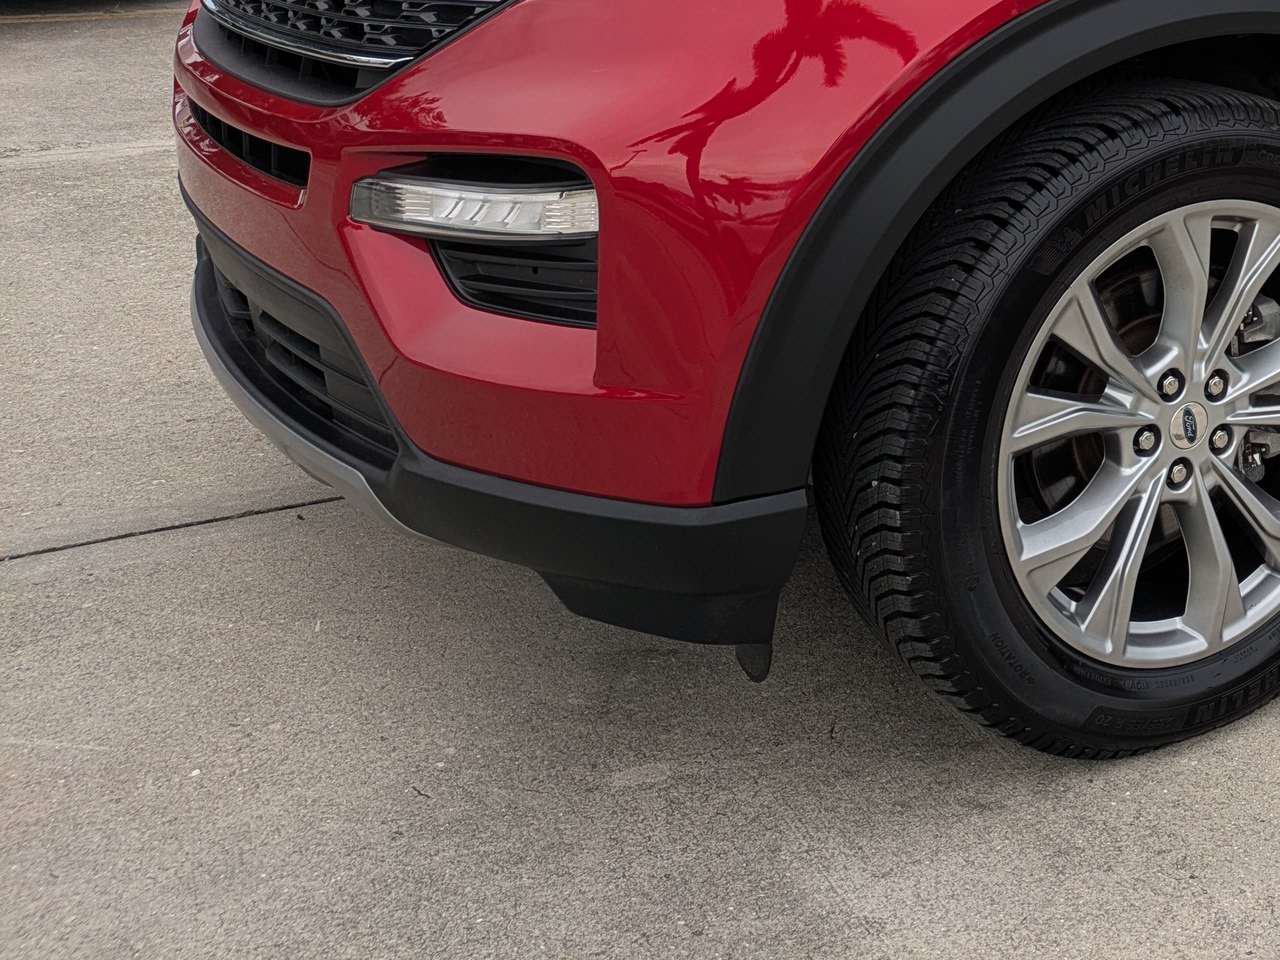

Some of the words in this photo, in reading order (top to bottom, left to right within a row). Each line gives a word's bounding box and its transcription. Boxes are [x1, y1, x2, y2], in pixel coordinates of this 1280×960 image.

[1085, 139, 1240, 228] MICHELIN
[1184, 415, 1196, 437] Ford
[991, 631, 1031, 680] ROTATION
